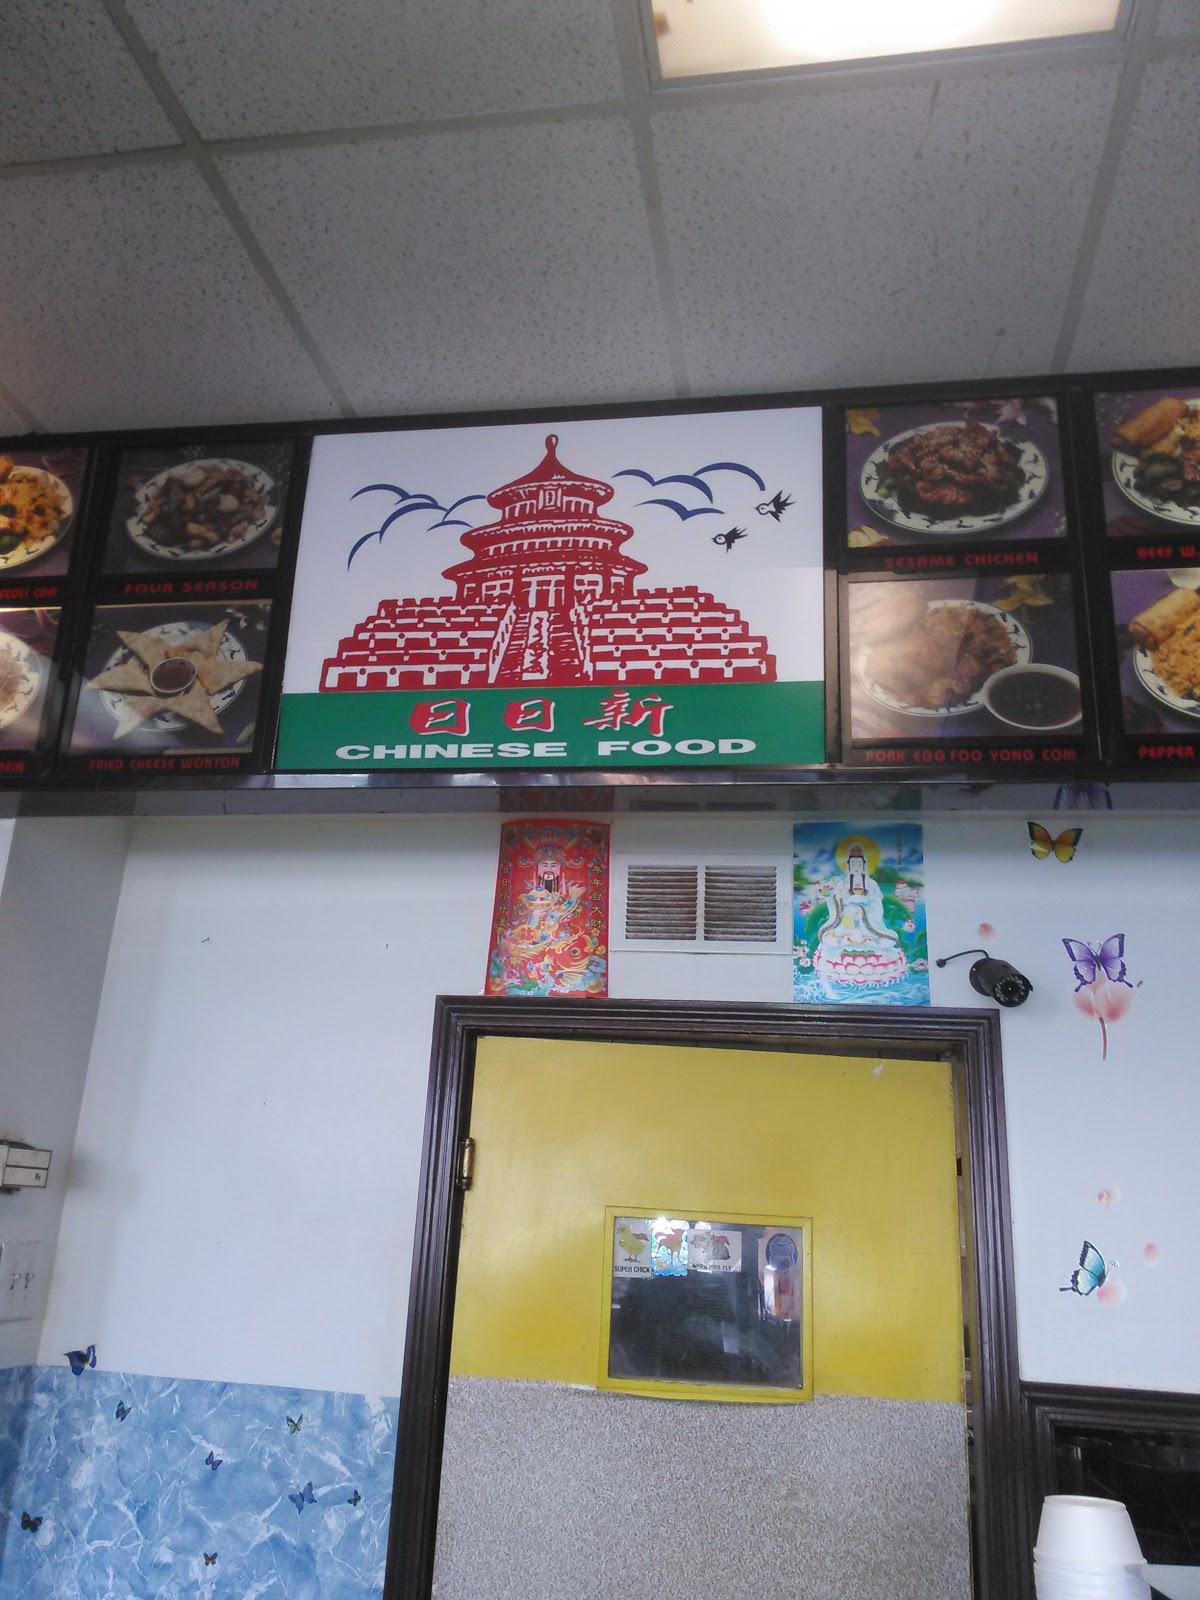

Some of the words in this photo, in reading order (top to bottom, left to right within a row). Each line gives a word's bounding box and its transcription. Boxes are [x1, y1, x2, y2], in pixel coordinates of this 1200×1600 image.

[886, 554, 955, 568] SESAME
[963, 552, 1039, 566] CHICKEN
[124, 582, 173, 593] FOUR
[182, 579, 259, 594] SEASON
[335, 741, 568, 761] CHINESE
[597, 738, 757, 756] FOOD
[865, 750, 905, 763] PORK
[912, 749, 945, 763] EGG
[950, 749, 982, 763] FOO
[89, 759, 124, 770] FRIED
[129, 759, 175, 769] CHEESE
[181, 757, 240, 769] WONTON
[614, 1265, 632, 1273] SUPER
